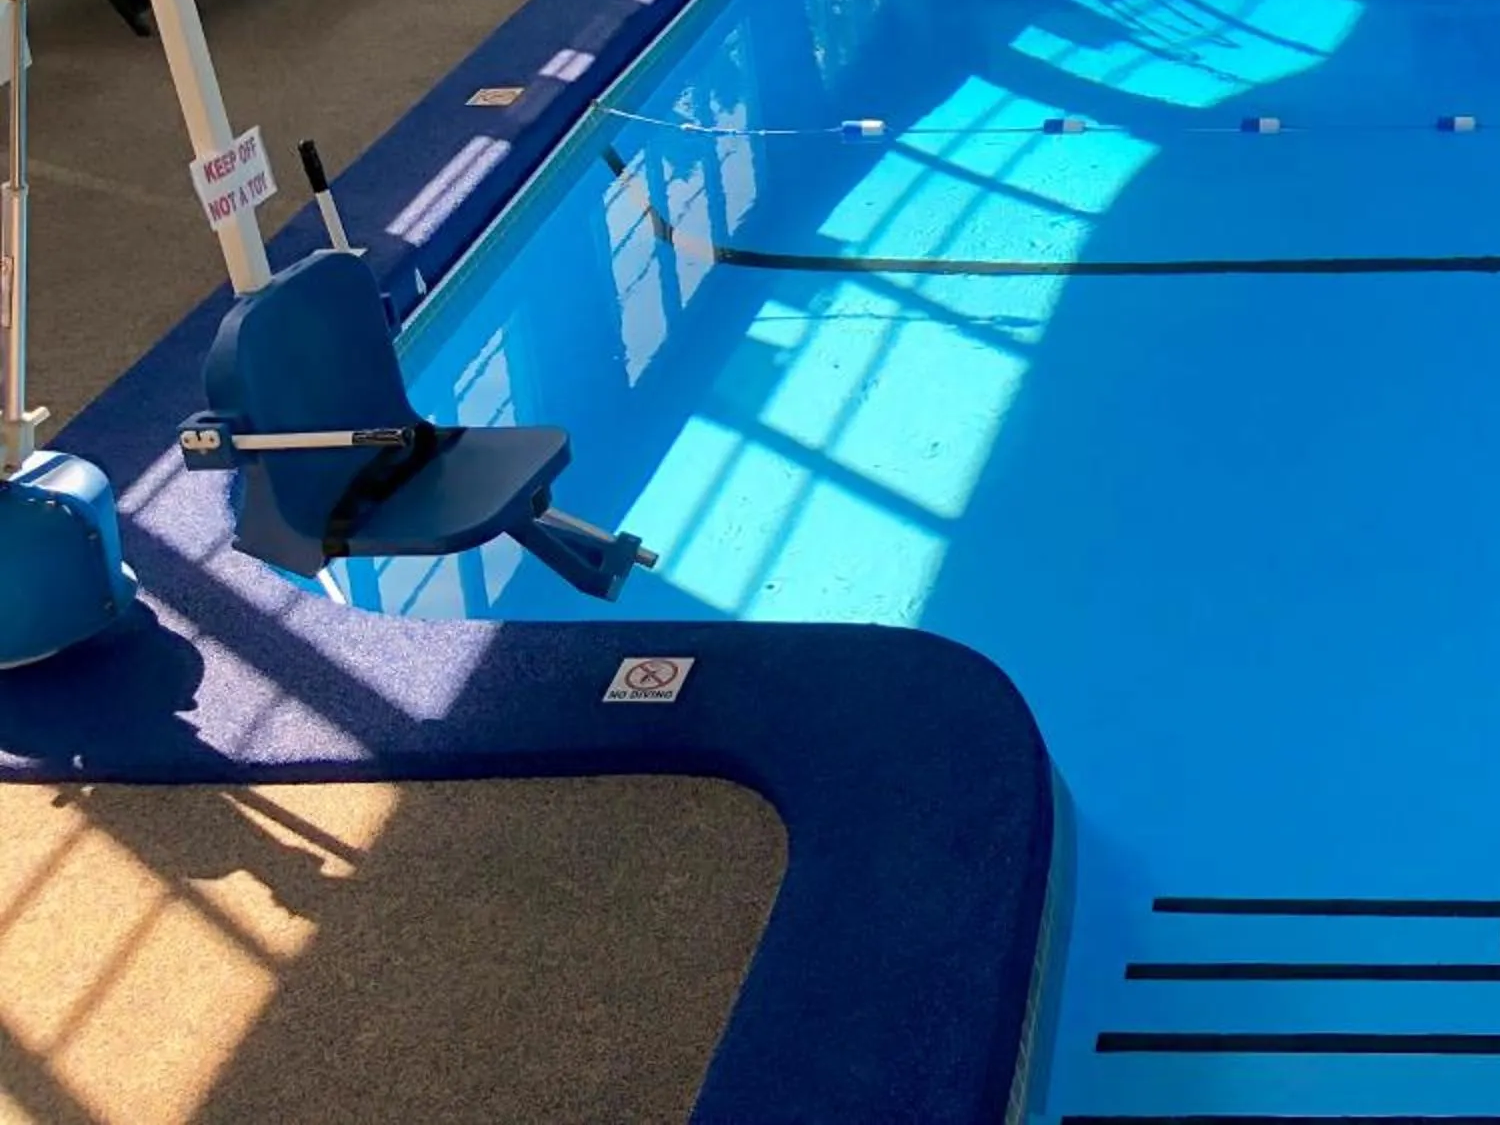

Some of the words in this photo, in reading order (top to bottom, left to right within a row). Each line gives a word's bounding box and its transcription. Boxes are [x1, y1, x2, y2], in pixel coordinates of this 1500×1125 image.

[203, 150, 237, 183] KEEP
[238, 136, 257, 164] OFF
[208, 191, 237, 222] NOT
[239, 186, 249, 207] A
[246, 170, 268, 199] TOY
[608, 690, 627, 700] NO
[629, 690, 673, 700] DIVING
